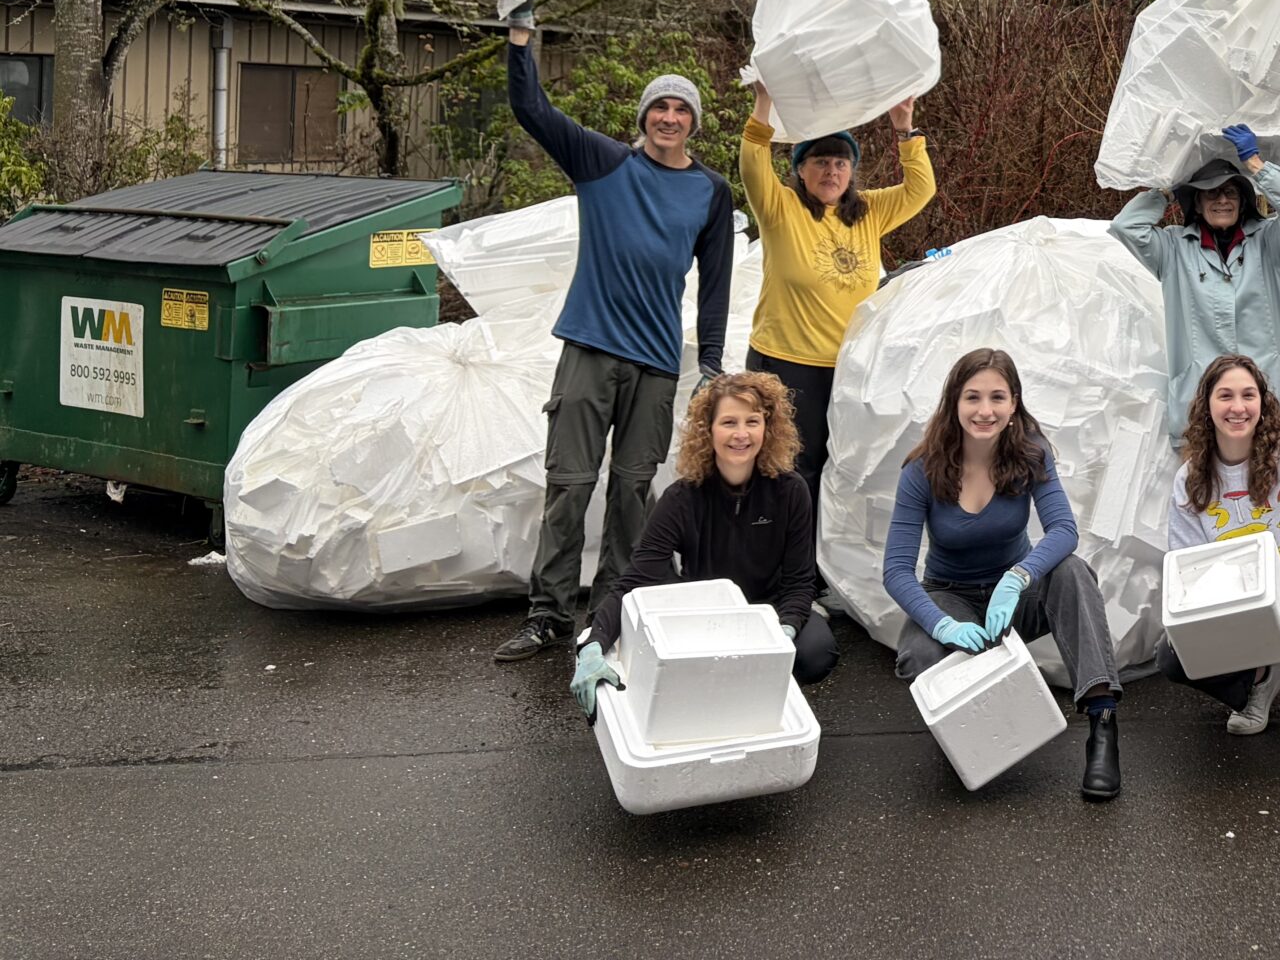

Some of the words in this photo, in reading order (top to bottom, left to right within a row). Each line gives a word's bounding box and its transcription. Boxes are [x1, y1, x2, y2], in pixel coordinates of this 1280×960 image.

[380, 233, 403, 241] CAUTION
[70, 306, 132, 346] WM
[96, 344, 134, 356] MANAGEMENT
[70, 364, 90, 379] 800
[92, 366, 111, 382] 592
[114, 370, 136, 386] 9995
